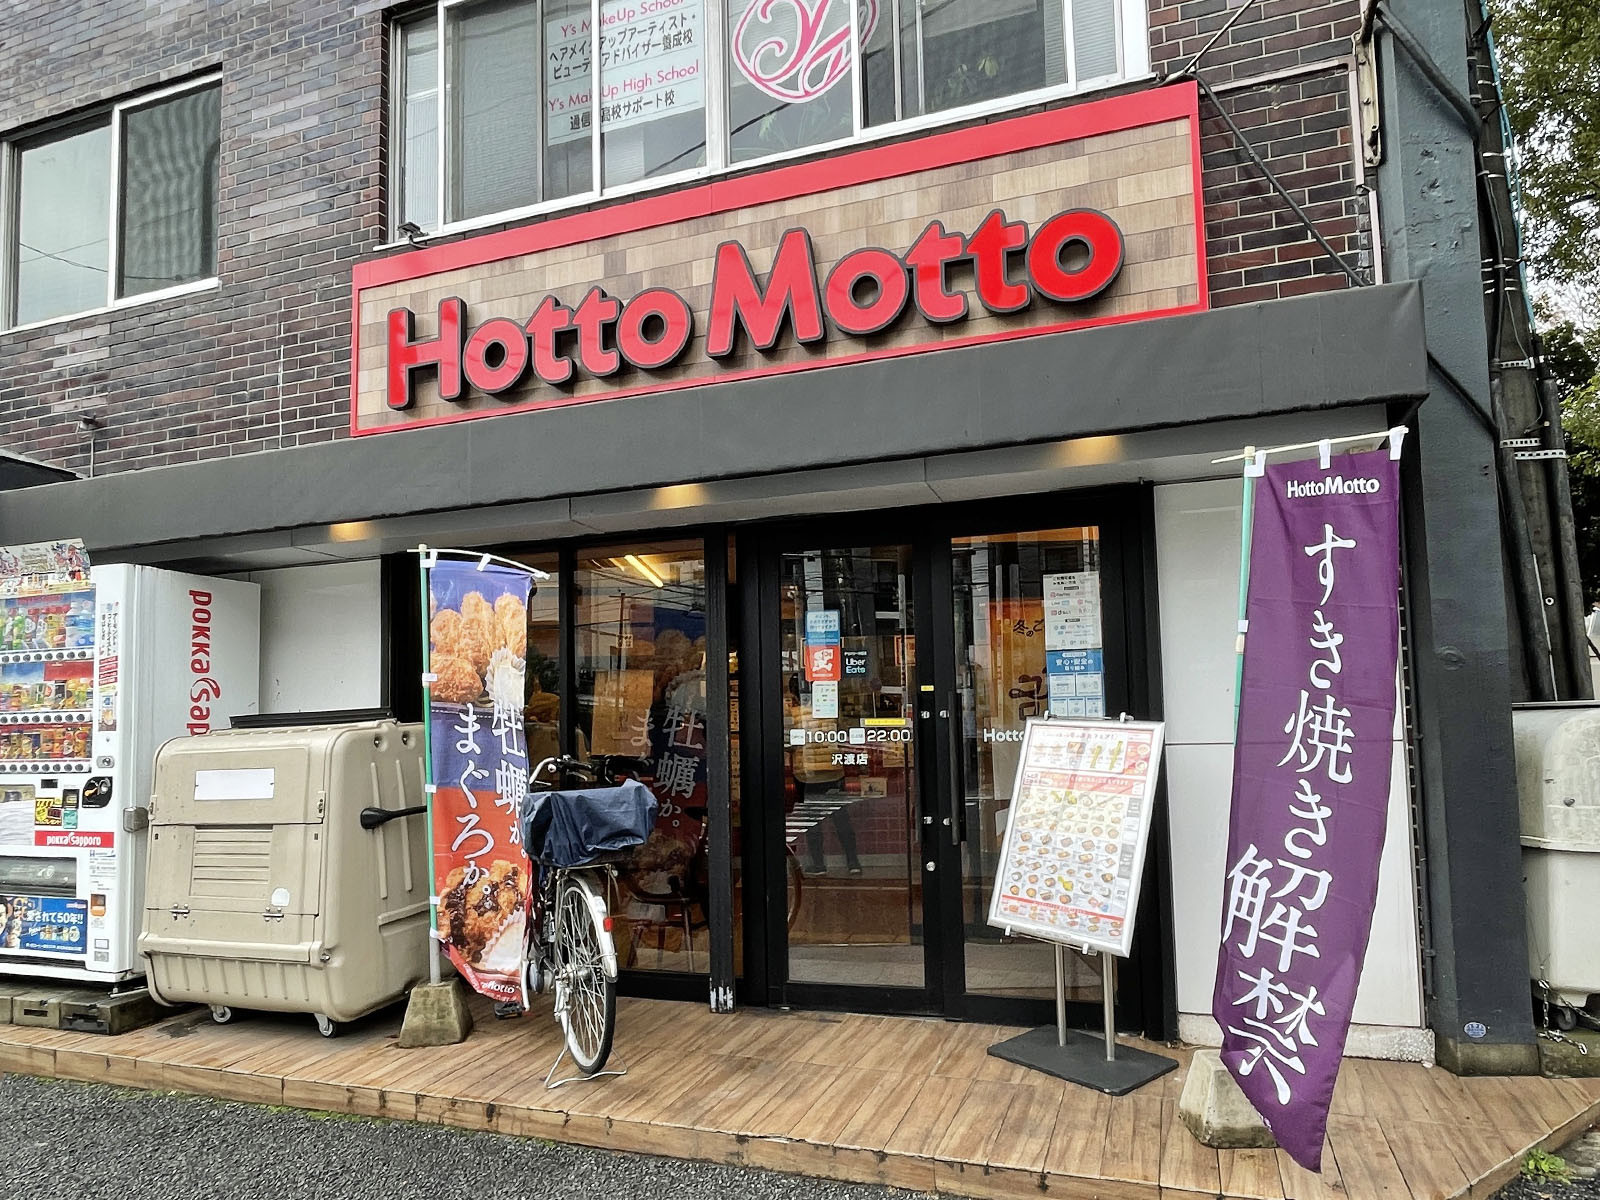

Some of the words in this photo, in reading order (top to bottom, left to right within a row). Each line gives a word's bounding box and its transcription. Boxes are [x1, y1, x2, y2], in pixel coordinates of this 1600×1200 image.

[549, 13, 697, 62] ヘアメイアップアーティスト・
[561, 23, 577, 38] Y's
[581, 8, 636, 33] MkeUp
[640, 0, 684, 15] Schoo
[553, 28, 694, 80] ビューテアドバイザー養成校
[548, 99, 565, 112] Y's
[568, 85, 619, 107] MakUp
[623, 73, 653, 93] High
[657, 59, 700, 83] School
[569, 89, 676, 131] 通信高校サポート校
[387, 285, 694, 410] Hotto
[705, 207, 1126, 361] Motto
[1286, 475, 1380, 499] HottoMotto
[845, 657, 866, 666] Uber
[845, 666, 866, 674] Eats
[806, 730, 847, 743] 10:00
[866, 729, 911, 742] 22:00
[831, 753, 869, 765] 沢渡店
